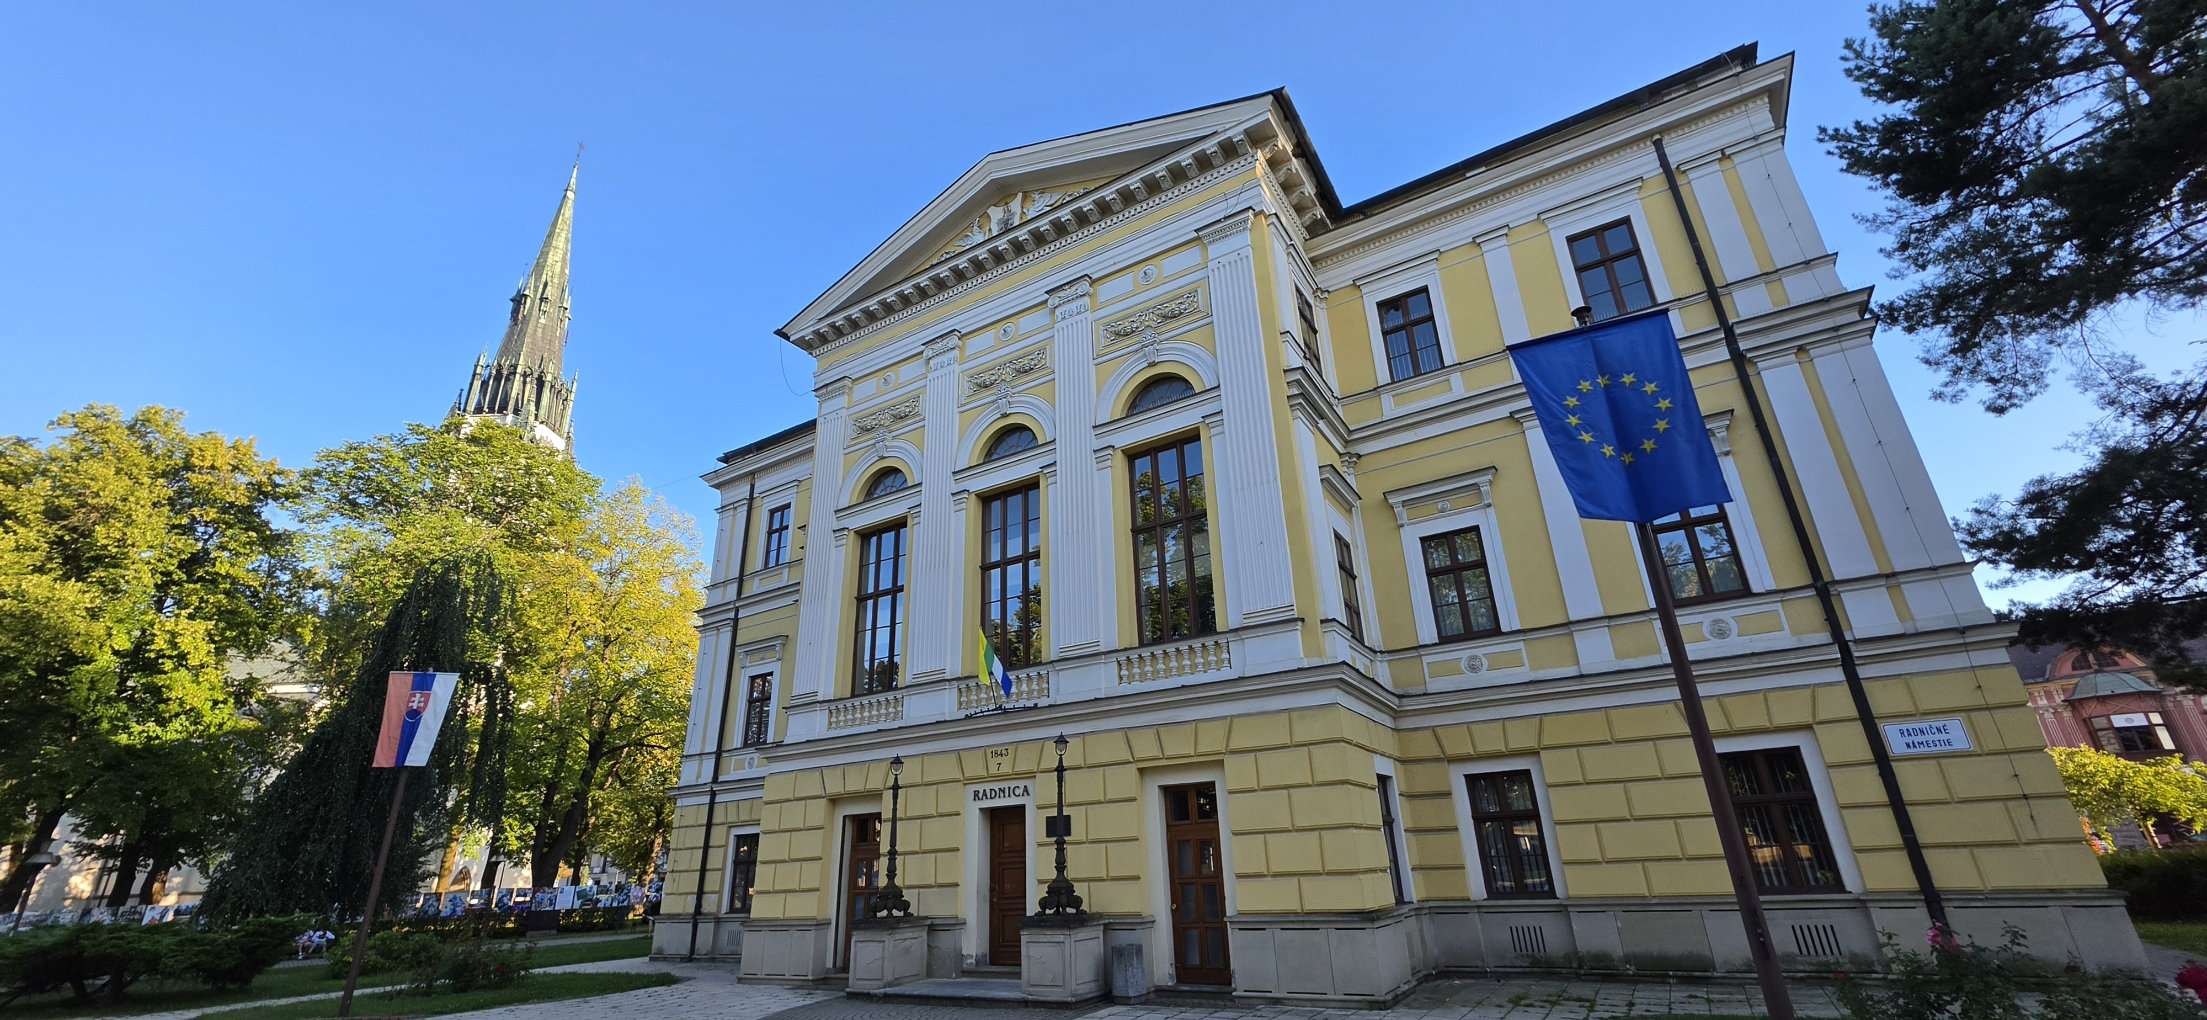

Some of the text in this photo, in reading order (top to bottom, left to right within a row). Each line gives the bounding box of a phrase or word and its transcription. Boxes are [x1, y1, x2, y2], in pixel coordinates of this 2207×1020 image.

[1899, 724, 1950, 738] RADNIČNÉ
[1905, 738, 1953, 750] NÁMESTIE
[990, 748, 1009, 759] 1843
[996, 762, 1002, 771] 7
[973, 785, 1030, 801] RADNICA
